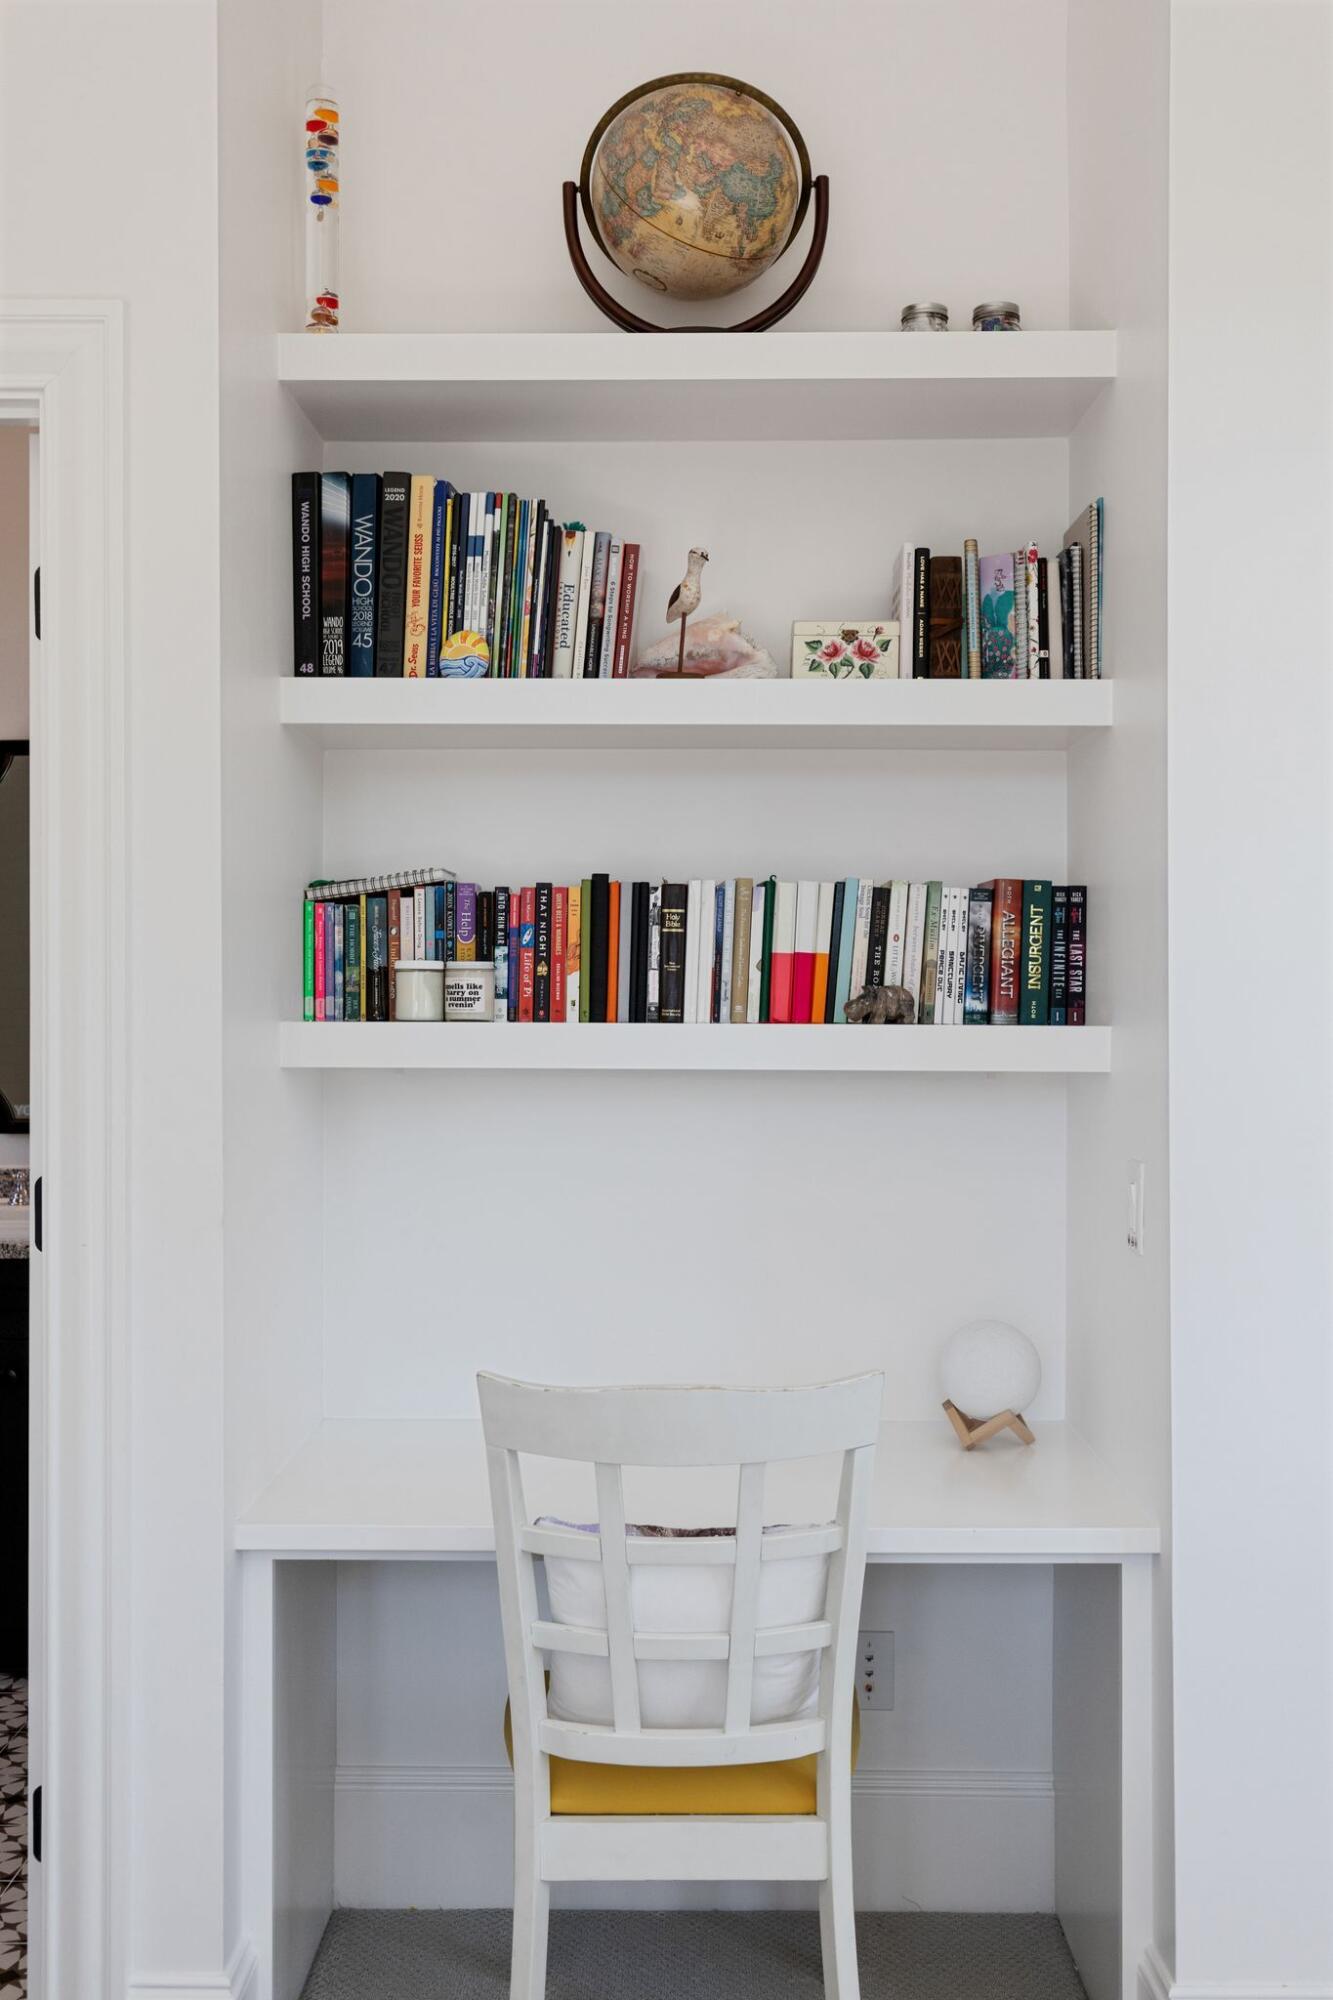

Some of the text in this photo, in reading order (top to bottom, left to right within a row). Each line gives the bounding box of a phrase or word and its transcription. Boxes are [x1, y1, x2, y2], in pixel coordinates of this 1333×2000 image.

[301, 501, 311, 620] WANDO HIGH SCHOOL
[354, 514, 373, 596] WANDO
[412, 534, 423, 608] YOUR FAVORITE SEUSS
[628, 572, 633, 580] TO
[432, 599, 438, 608] DI
[323, 616, 344, 627] WANDO
[352, 611, 373, 620] 2018
[560, 584, 575, 649] Educated
[352, 633, 372, 648] 45
[431, 627, 437, 635] LA
[604, 614, 613, 652] Songwriting
[323, 640, 343, 654] 2019
[300, 663, 314, 672] 48
[323, 655, 344, 665] LEGEND
[409, 643, 419, 678] Dr. Seuss
[460, 912, 472, 936] Help
[1000, 910, 1015, 998] ALLEGIANT
[1028, 904, 1043, 990] INSURGENT
[1069, 944, 1082, 966] LAST
[971, 925, 985, 1004] DIVERGENT
[1053, 941, 1065, 987] INFINITE
[524, 974, 532, 984] of
[1069, 970, 1082, 992] STAR
[523, 987, 532, 997] Pi
